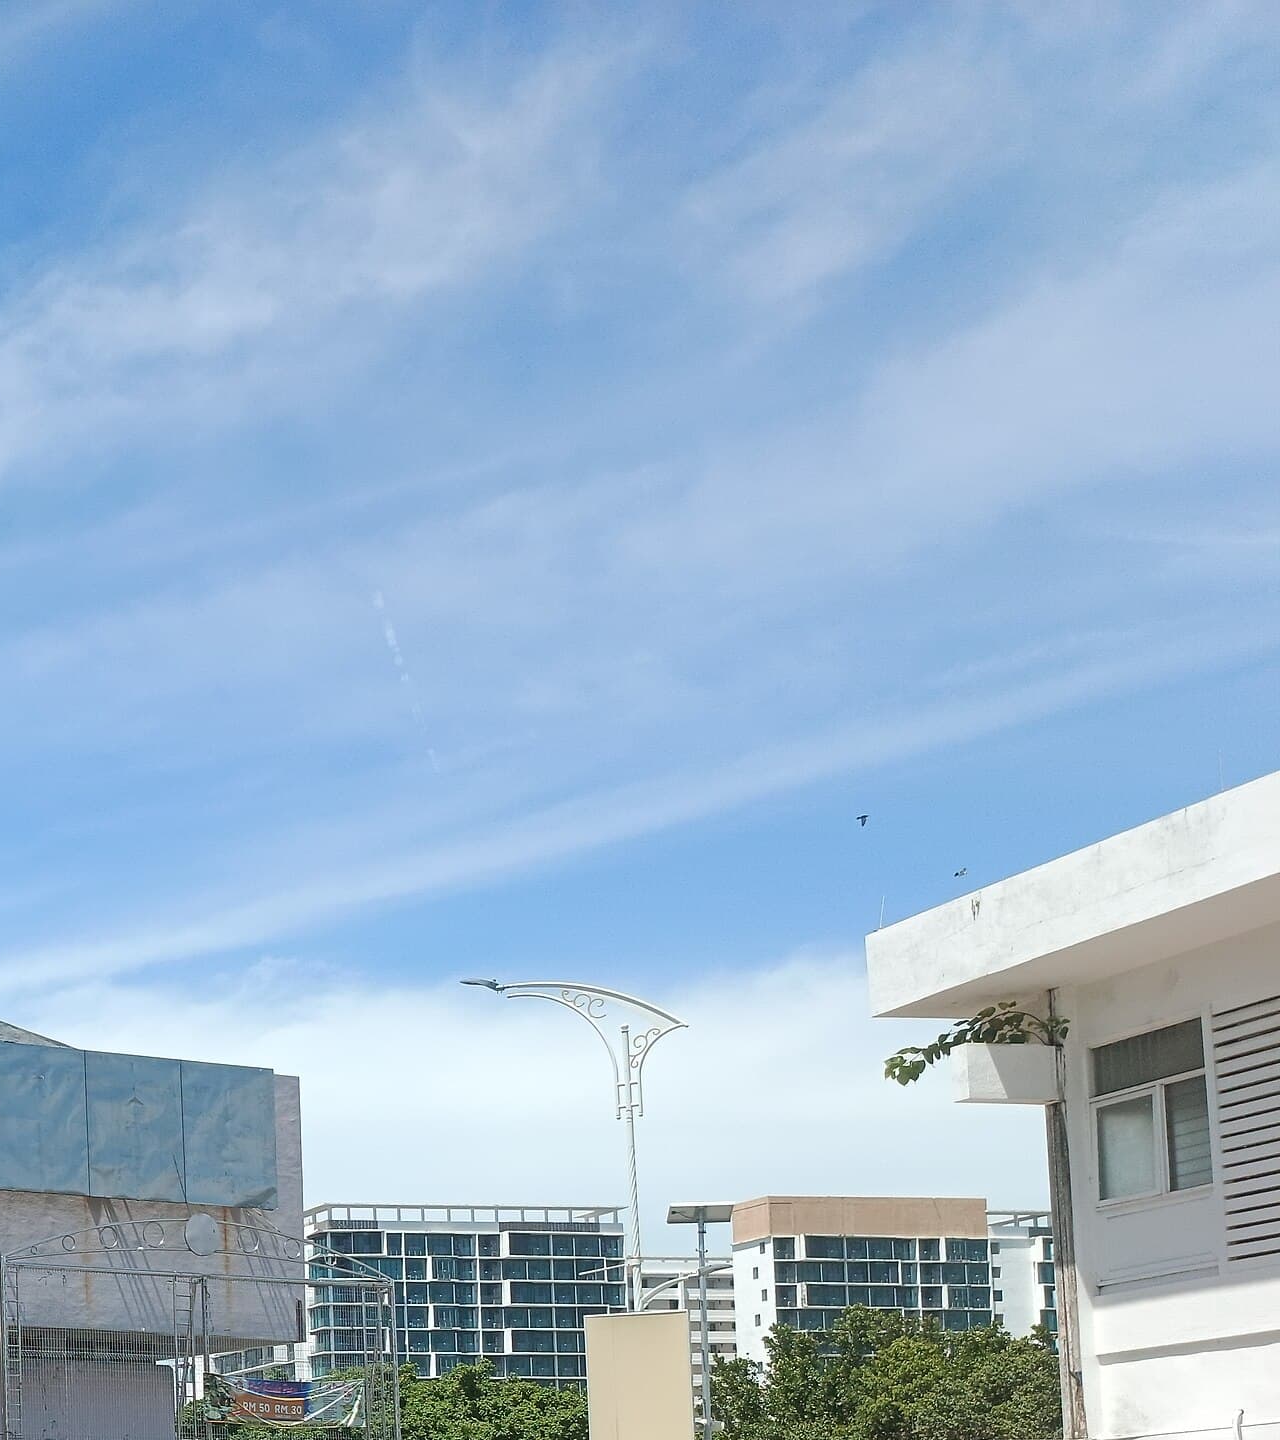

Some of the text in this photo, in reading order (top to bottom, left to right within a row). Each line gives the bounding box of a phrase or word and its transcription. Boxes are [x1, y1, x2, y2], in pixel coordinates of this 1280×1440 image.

[243, 1401, 256, 1412] RM
[259, 1403, 270, 1413] 50
[291, 1405, 302, 1415] 30
